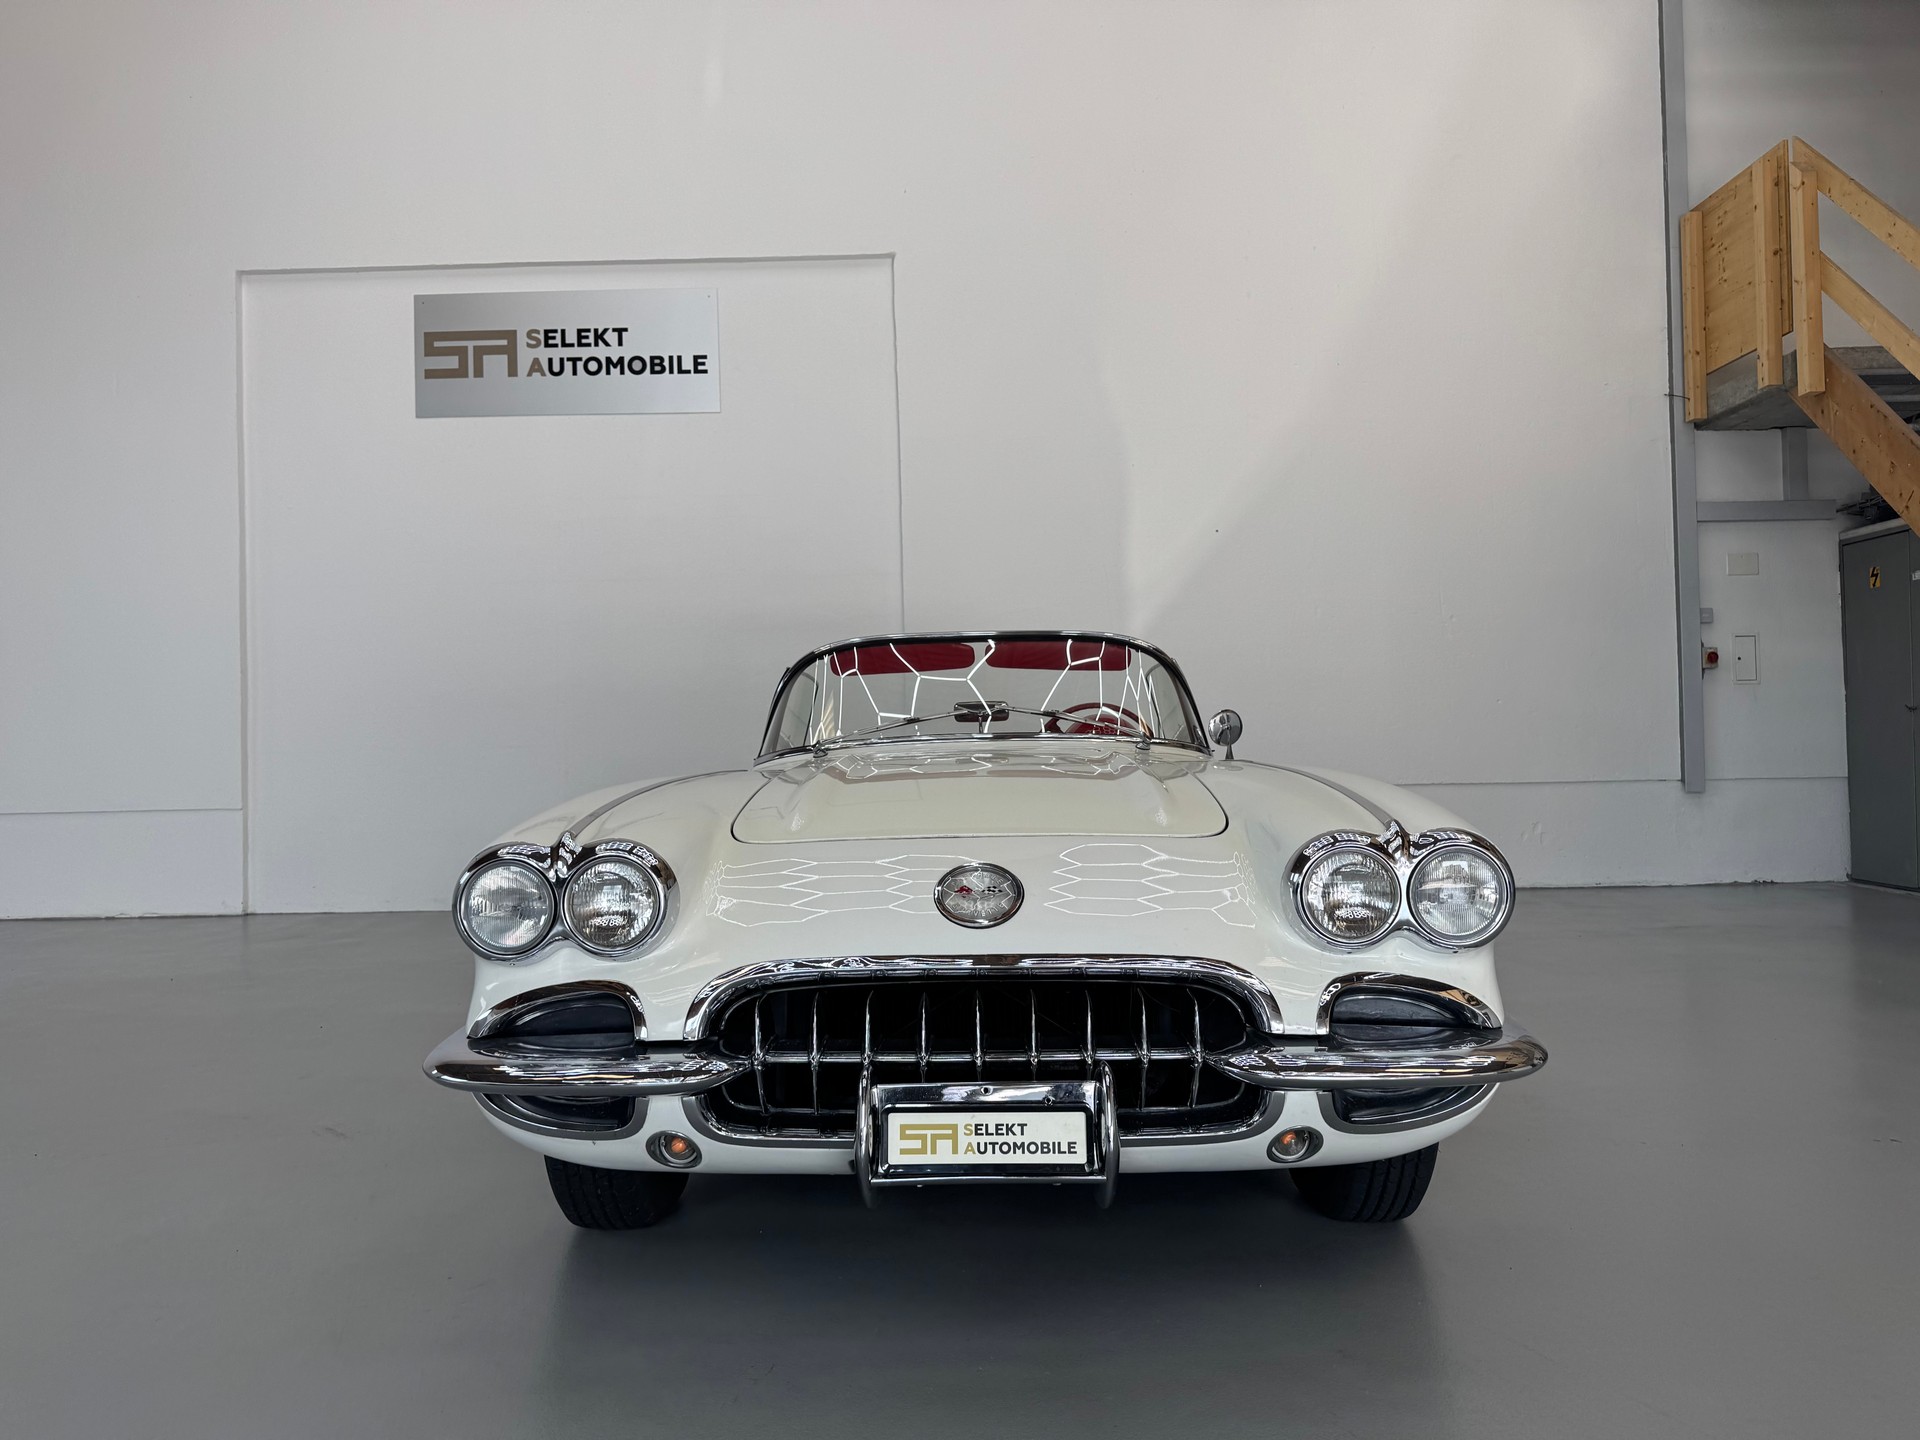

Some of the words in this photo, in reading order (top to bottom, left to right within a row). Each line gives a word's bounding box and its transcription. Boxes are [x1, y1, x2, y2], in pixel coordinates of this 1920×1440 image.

[525, 327, 629, 349] SELEKT
[526, 354, 709, 377] AUTOMOBILE
[963, 1123, 1028, 1137] SELEKT
[963, 1141, 1078, 1156] AUTOMOBILE
